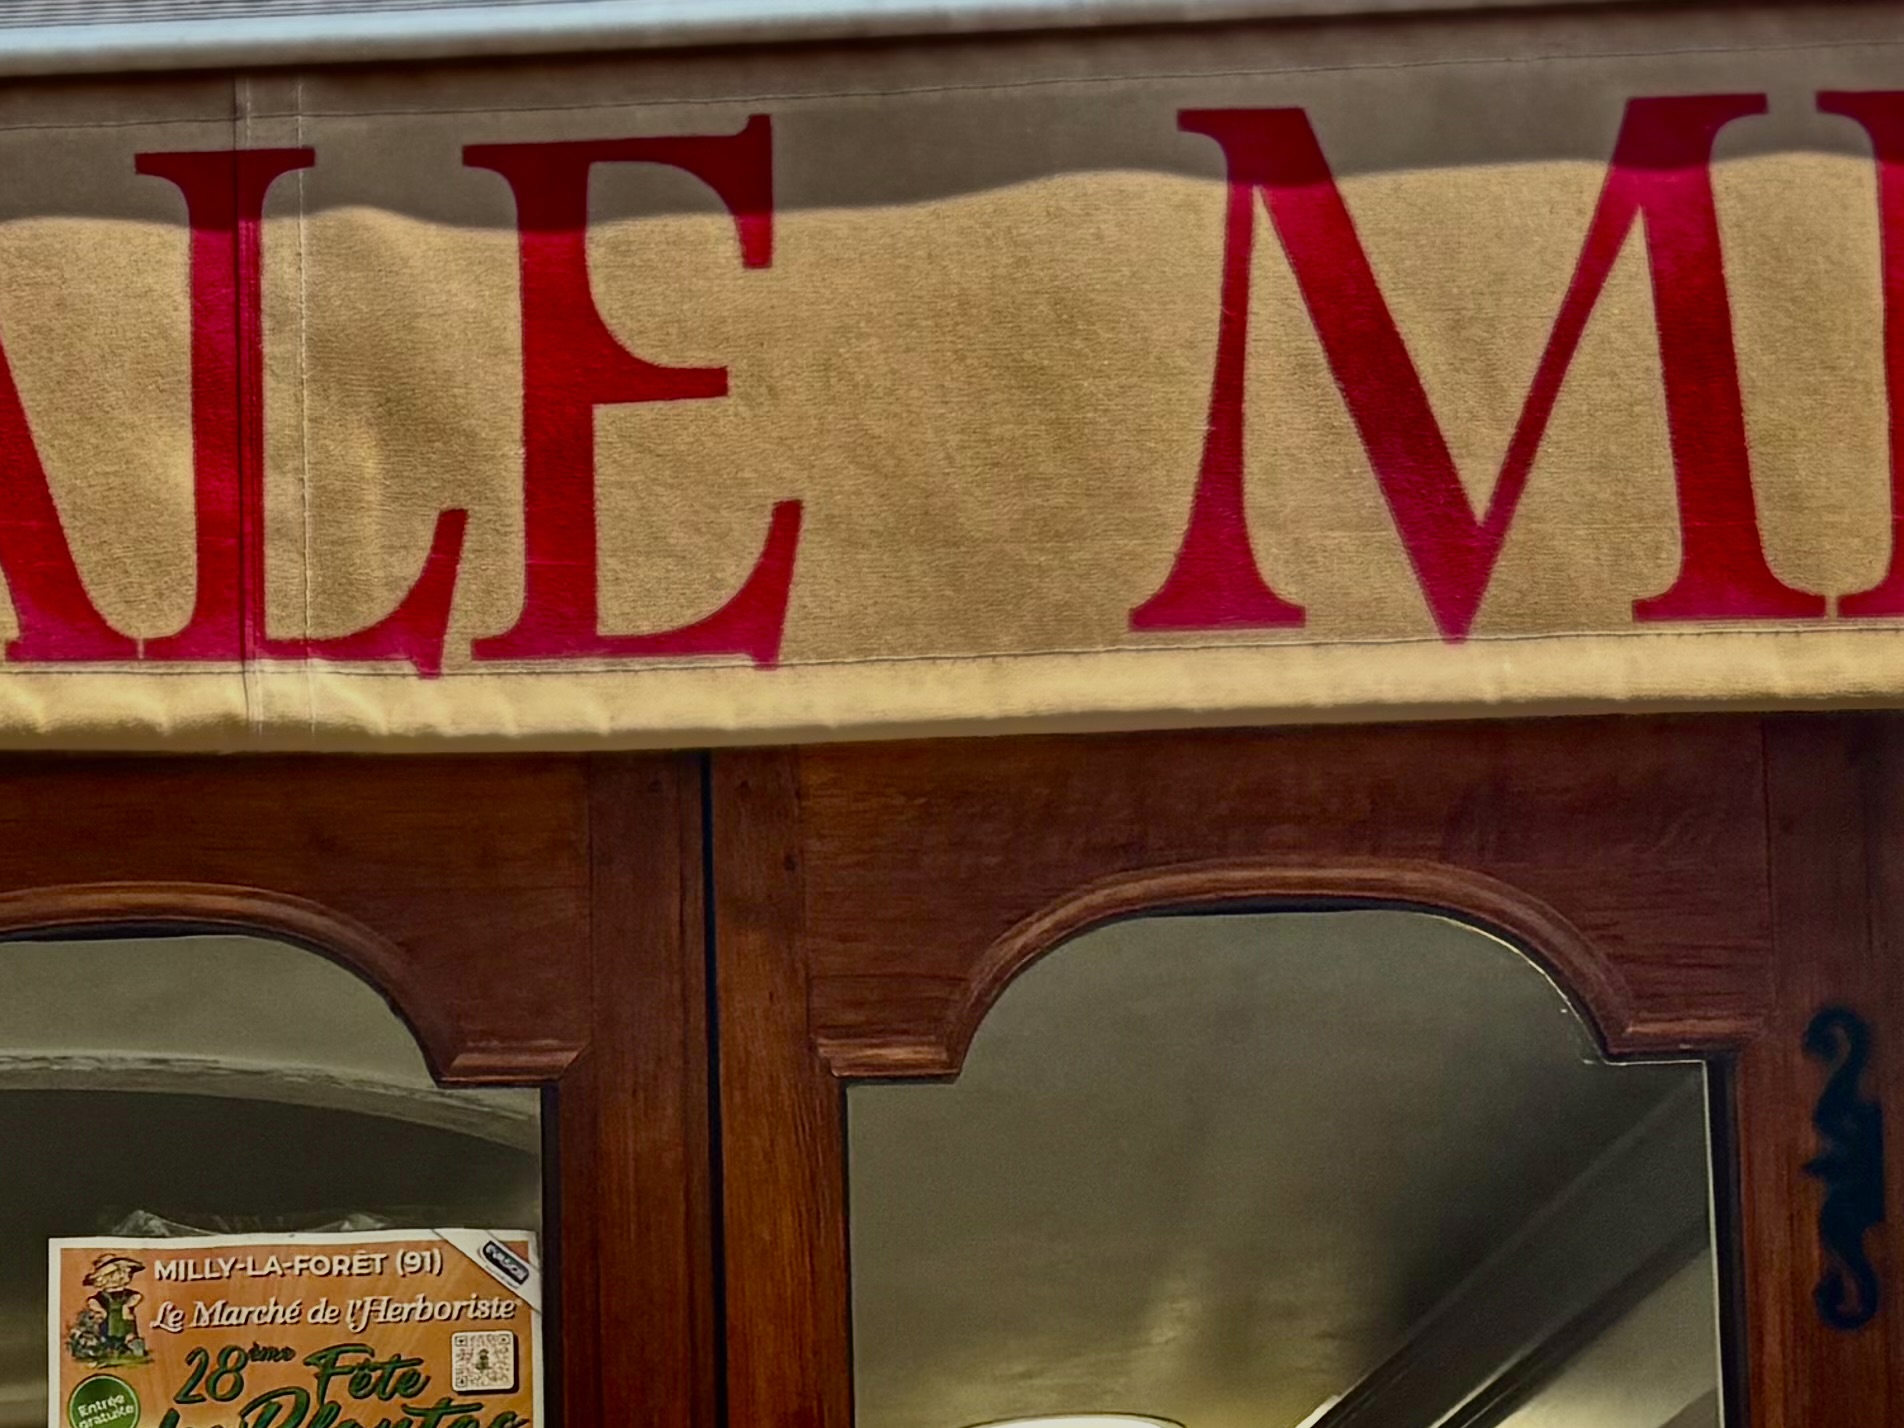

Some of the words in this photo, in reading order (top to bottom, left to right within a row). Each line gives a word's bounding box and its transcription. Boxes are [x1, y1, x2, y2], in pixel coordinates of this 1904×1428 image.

[153, 1248, 387, 1282] MILLY-LA-FORÊT
[396, 1247, 442, 1276] (91)
[149, 1301, 185, 1333] Le
[189, 1296, 299, 1329] Marché
[307, 1295, 340, 1324] de
[345, 1292, 516, 1334] l'Herboriste
[303, 1342, 431, 1402] Fête
[77, 1394, 125, 1418] Entrée
